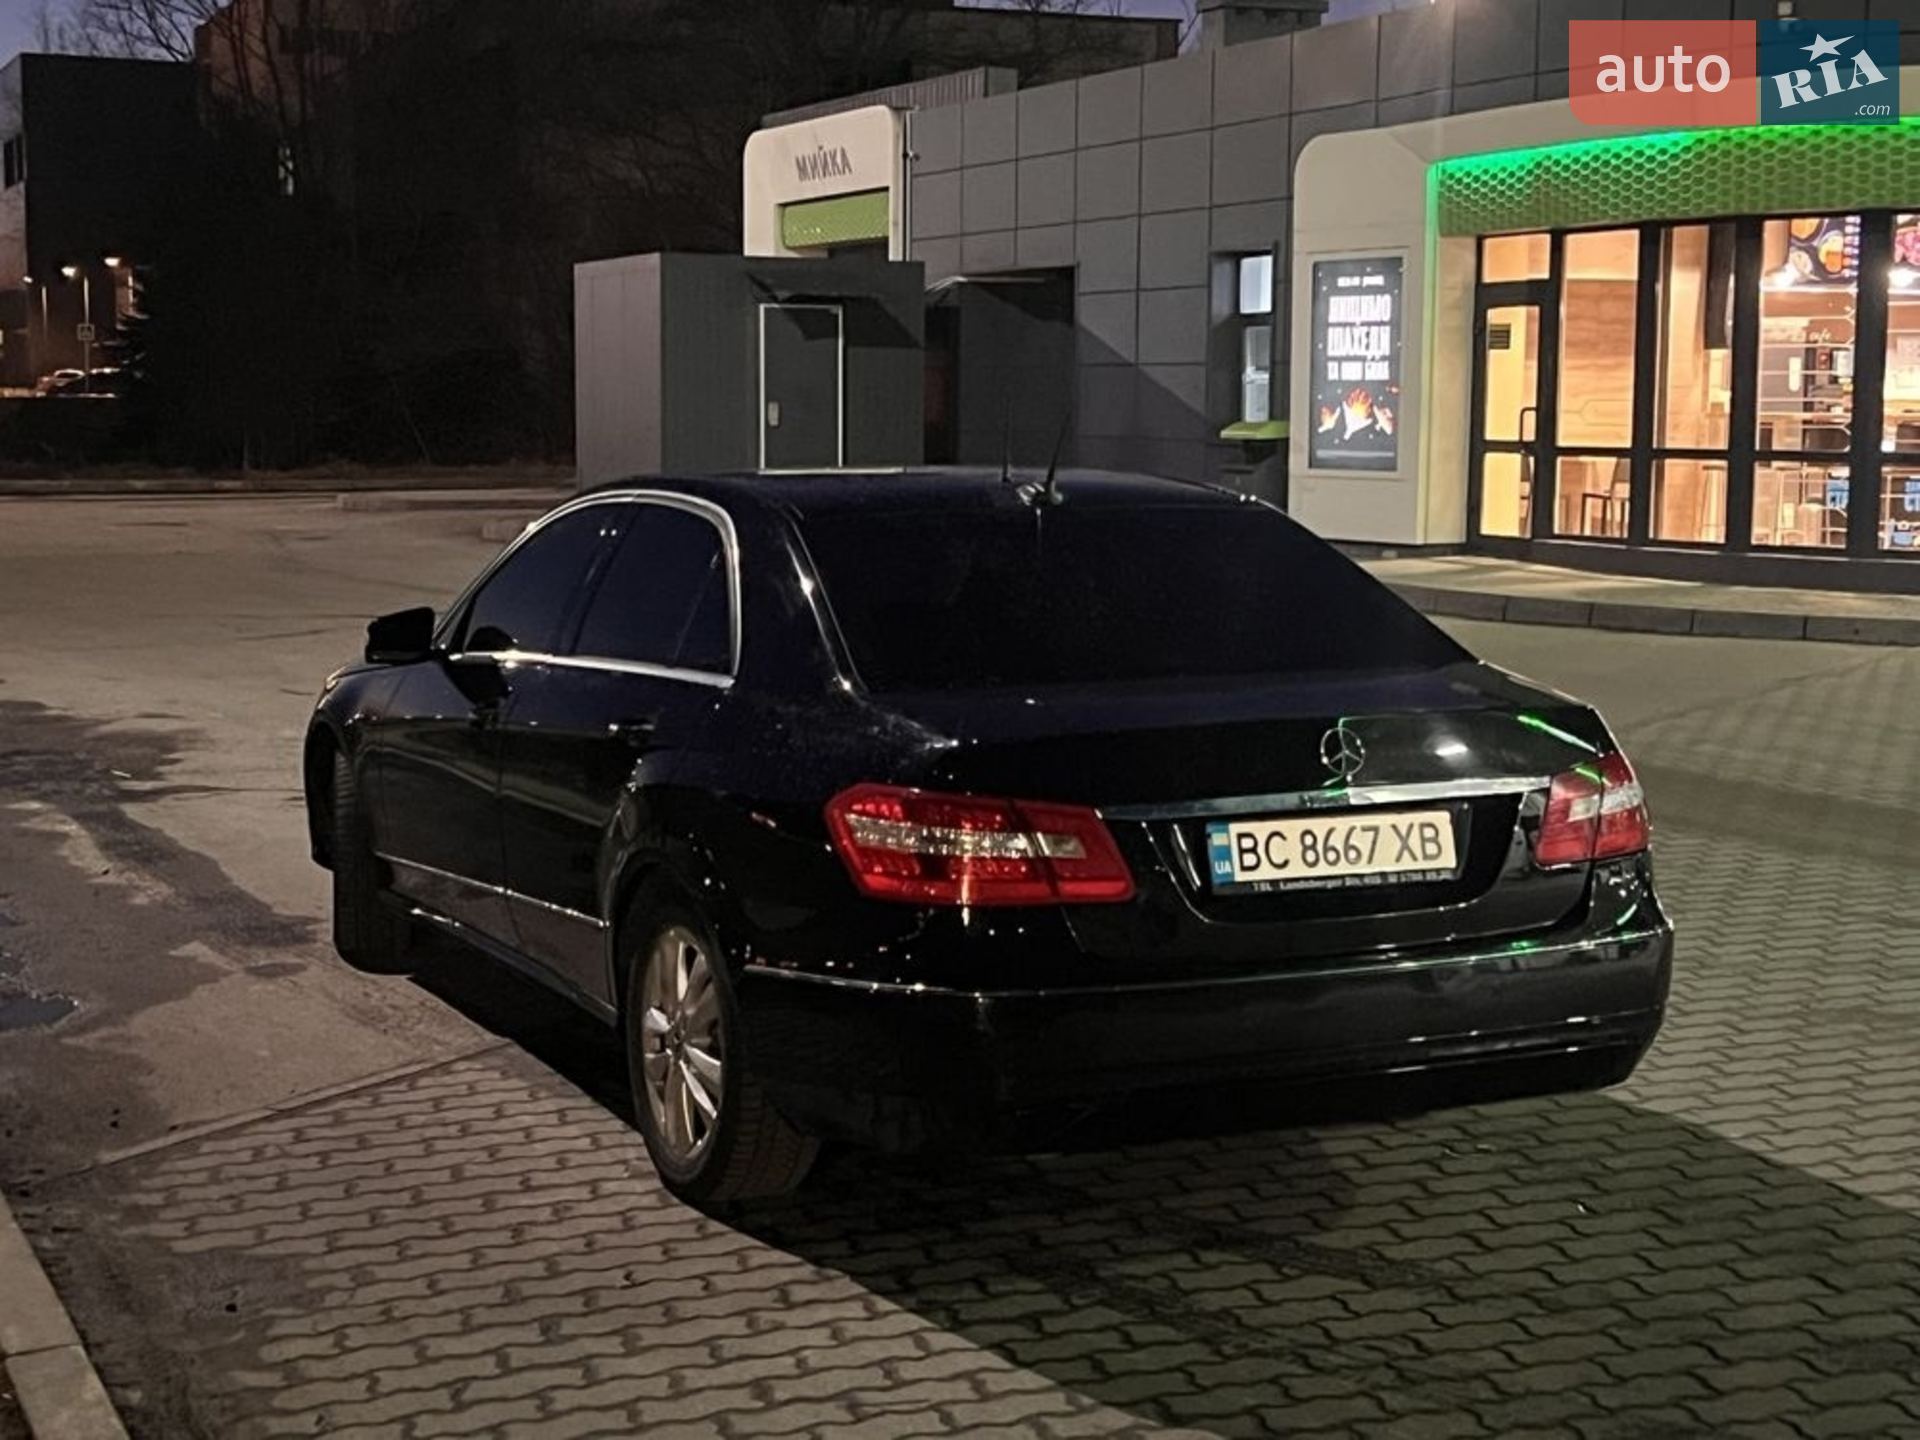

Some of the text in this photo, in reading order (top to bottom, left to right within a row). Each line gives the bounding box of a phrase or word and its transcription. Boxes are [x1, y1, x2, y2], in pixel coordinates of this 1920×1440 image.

[795, 145, 853, 182] МИЙКА
[1236, 821, 1442, 872] BC 8667 XB
[1215, 860, 1232, 875] UA
